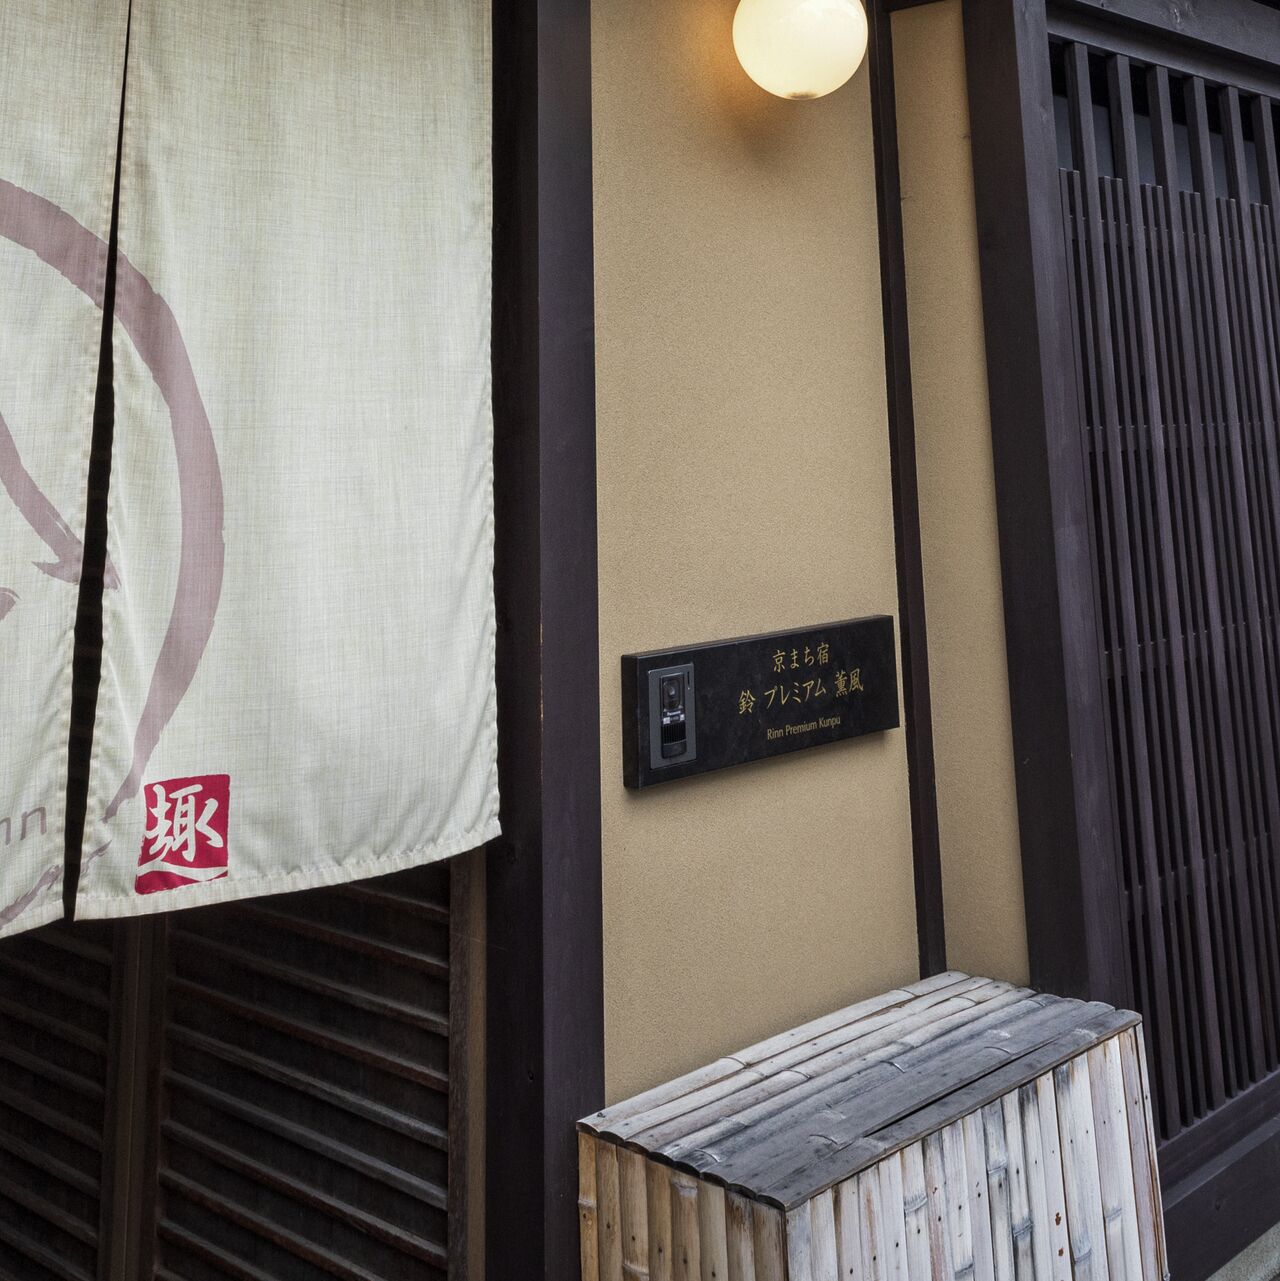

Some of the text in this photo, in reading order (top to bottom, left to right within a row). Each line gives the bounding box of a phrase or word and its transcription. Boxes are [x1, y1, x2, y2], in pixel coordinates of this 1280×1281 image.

[772, 642, 830, 673] 京まち宿
[738, 668, 864, 714] 鈴 プレミアム 薫風
[767, 727, 784, 740] Rinn
[785, 721, 818, 736] Premium
